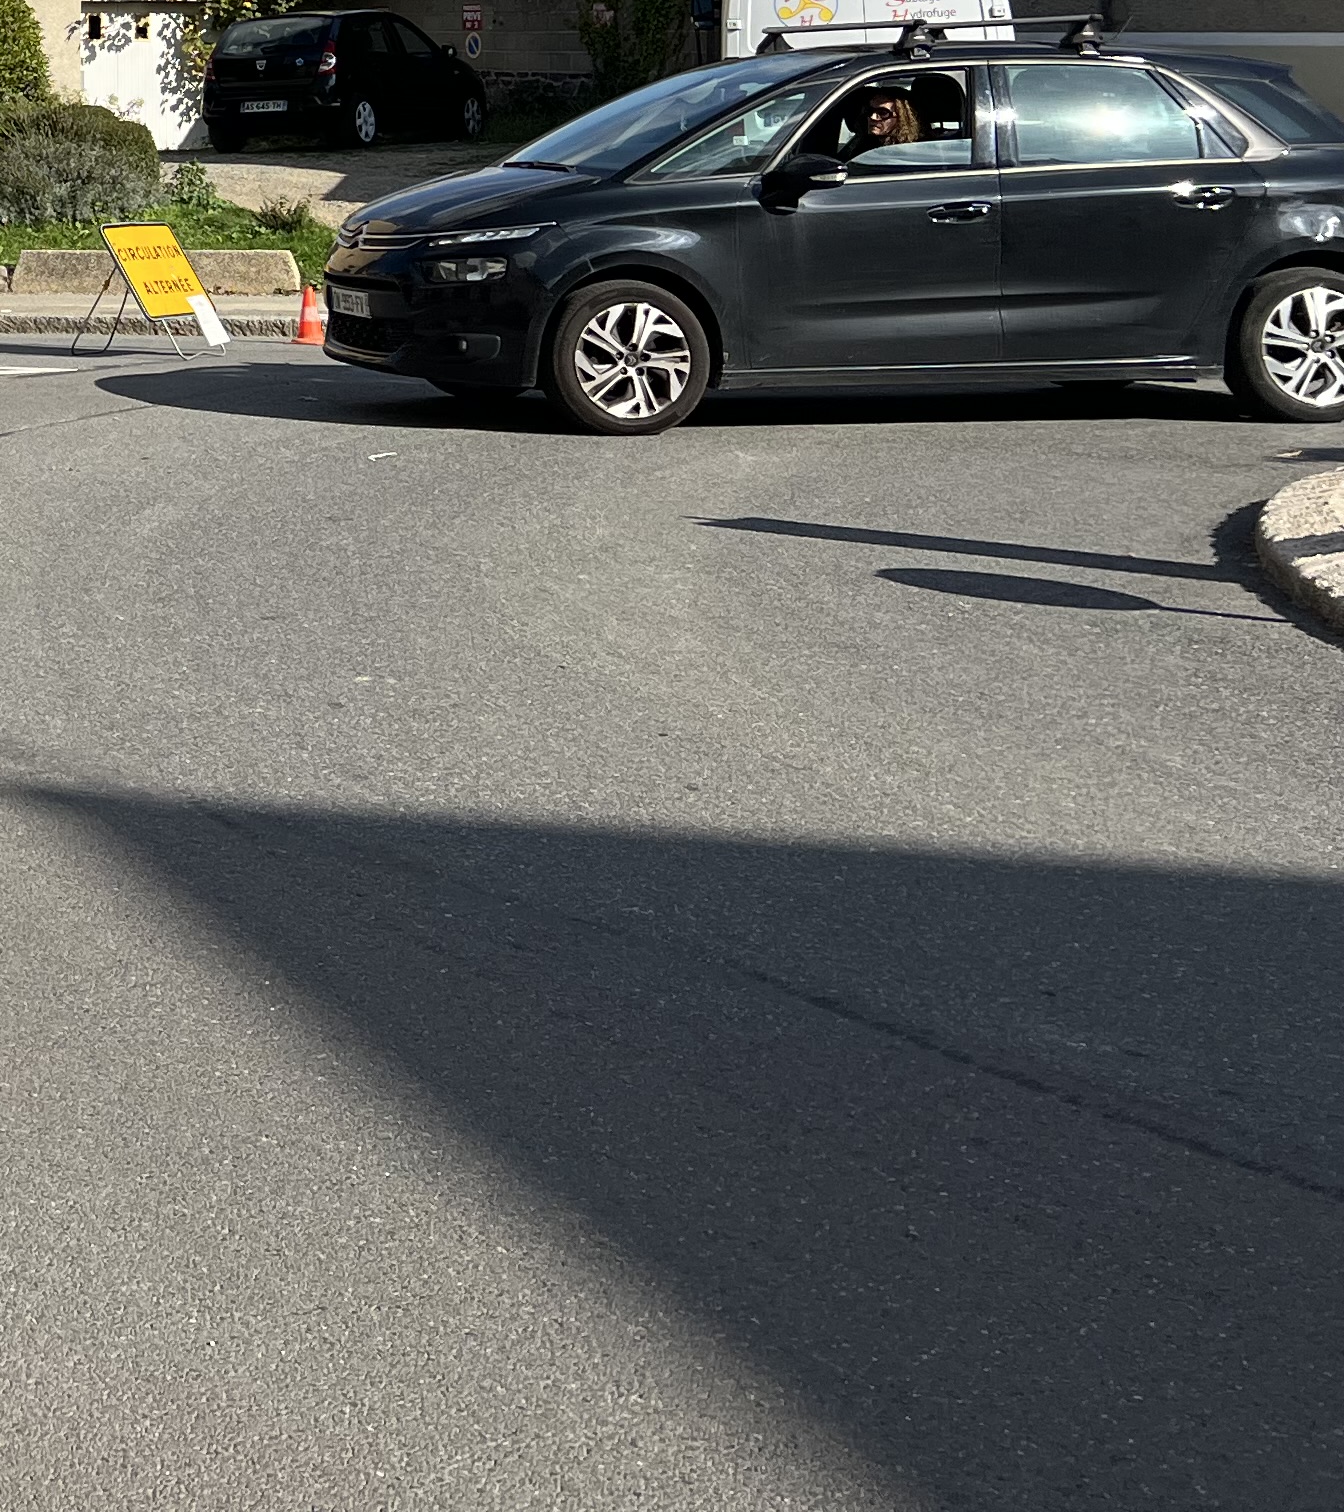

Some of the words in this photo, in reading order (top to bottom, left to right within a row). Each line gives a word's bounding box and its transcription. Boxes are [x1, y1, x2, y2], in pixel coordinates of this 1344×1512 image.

[891, 8, 957, 21] Hydrofuge
[117, 245, 182, 263] CIRCULATION
[143, 276, 195, 295] ALTERNÉE
